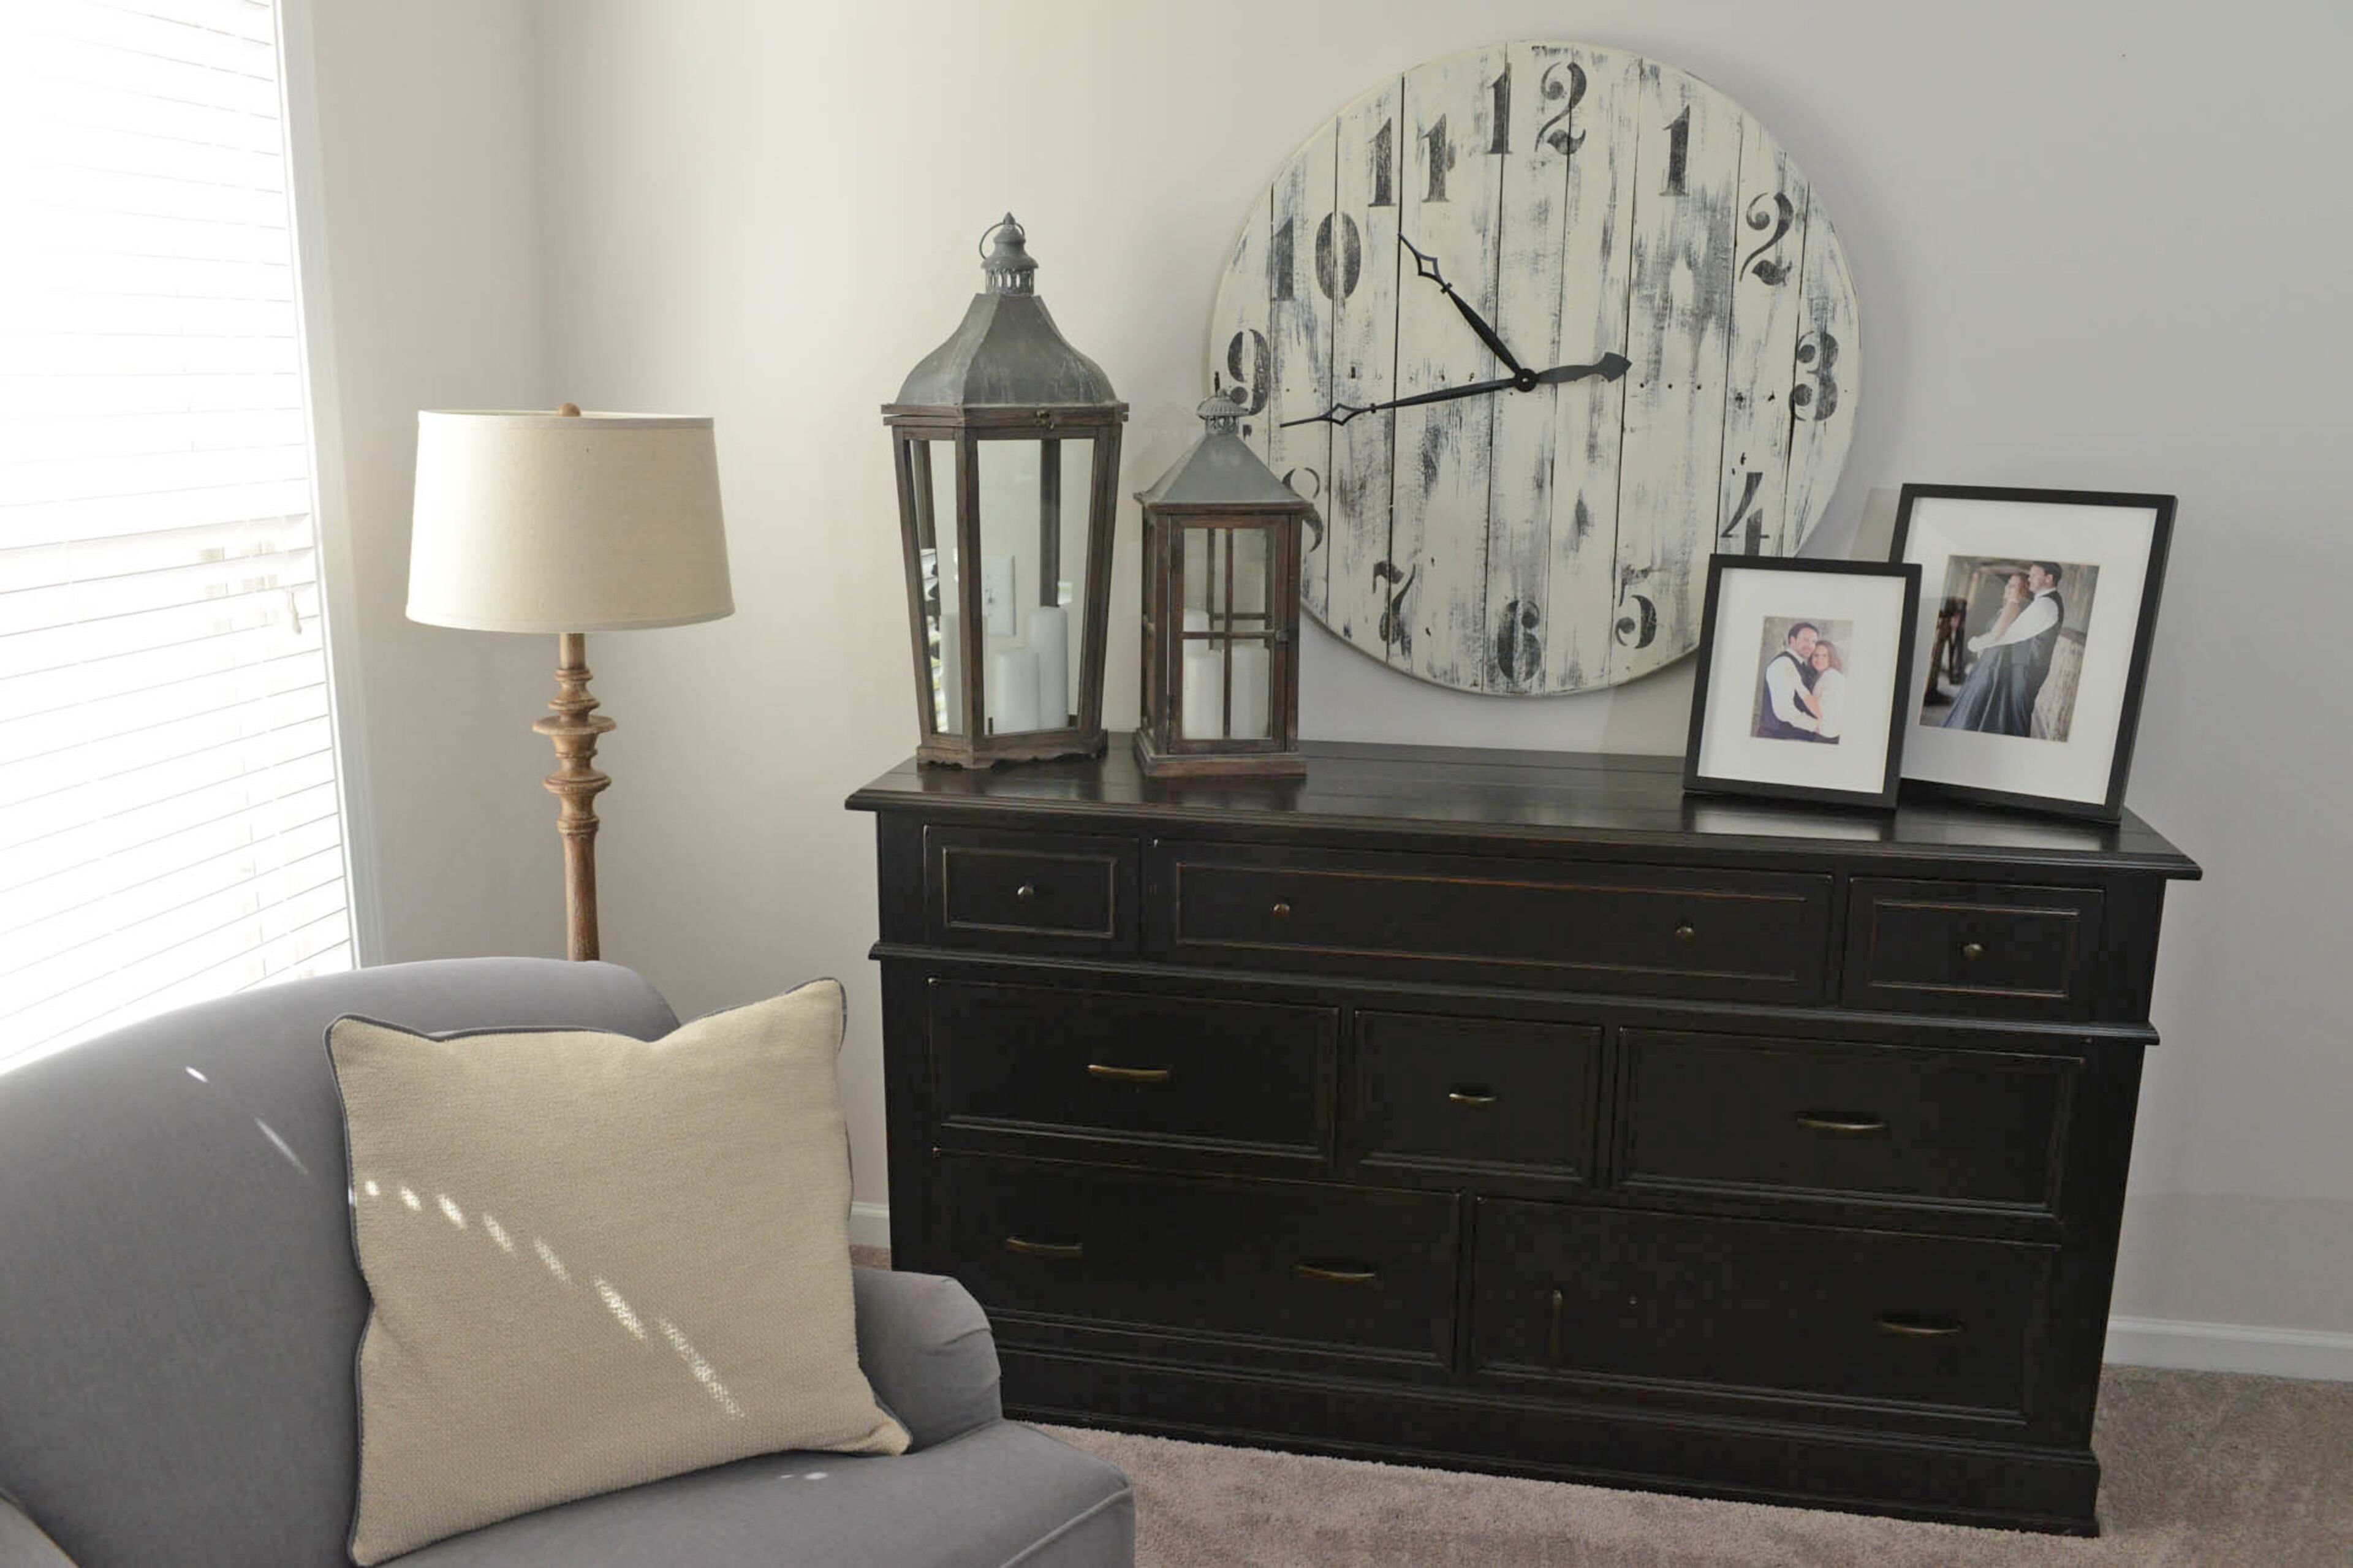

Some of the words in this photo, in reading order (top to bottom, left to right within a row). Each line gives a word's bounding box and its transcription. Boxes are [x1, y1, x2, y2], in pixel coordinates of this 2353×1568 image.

[1486, 61, 1587, 156] 12
[1659, 104, 1690, 197] 1
[1368, 113, 1451, 207] 11
[1271, 211, 1362, 301] 10
[1739, 191, 1794, 286] 2
[1227, 328, 1270, 417] 9
[1789, 330, 1838, 422] 3
[1719, 471, 1770, 556] 4
[1373, 561, 1416, 646] 7
[1496, 599, 1542, 682] 6
[1615, 564, 1657, 650] 5
